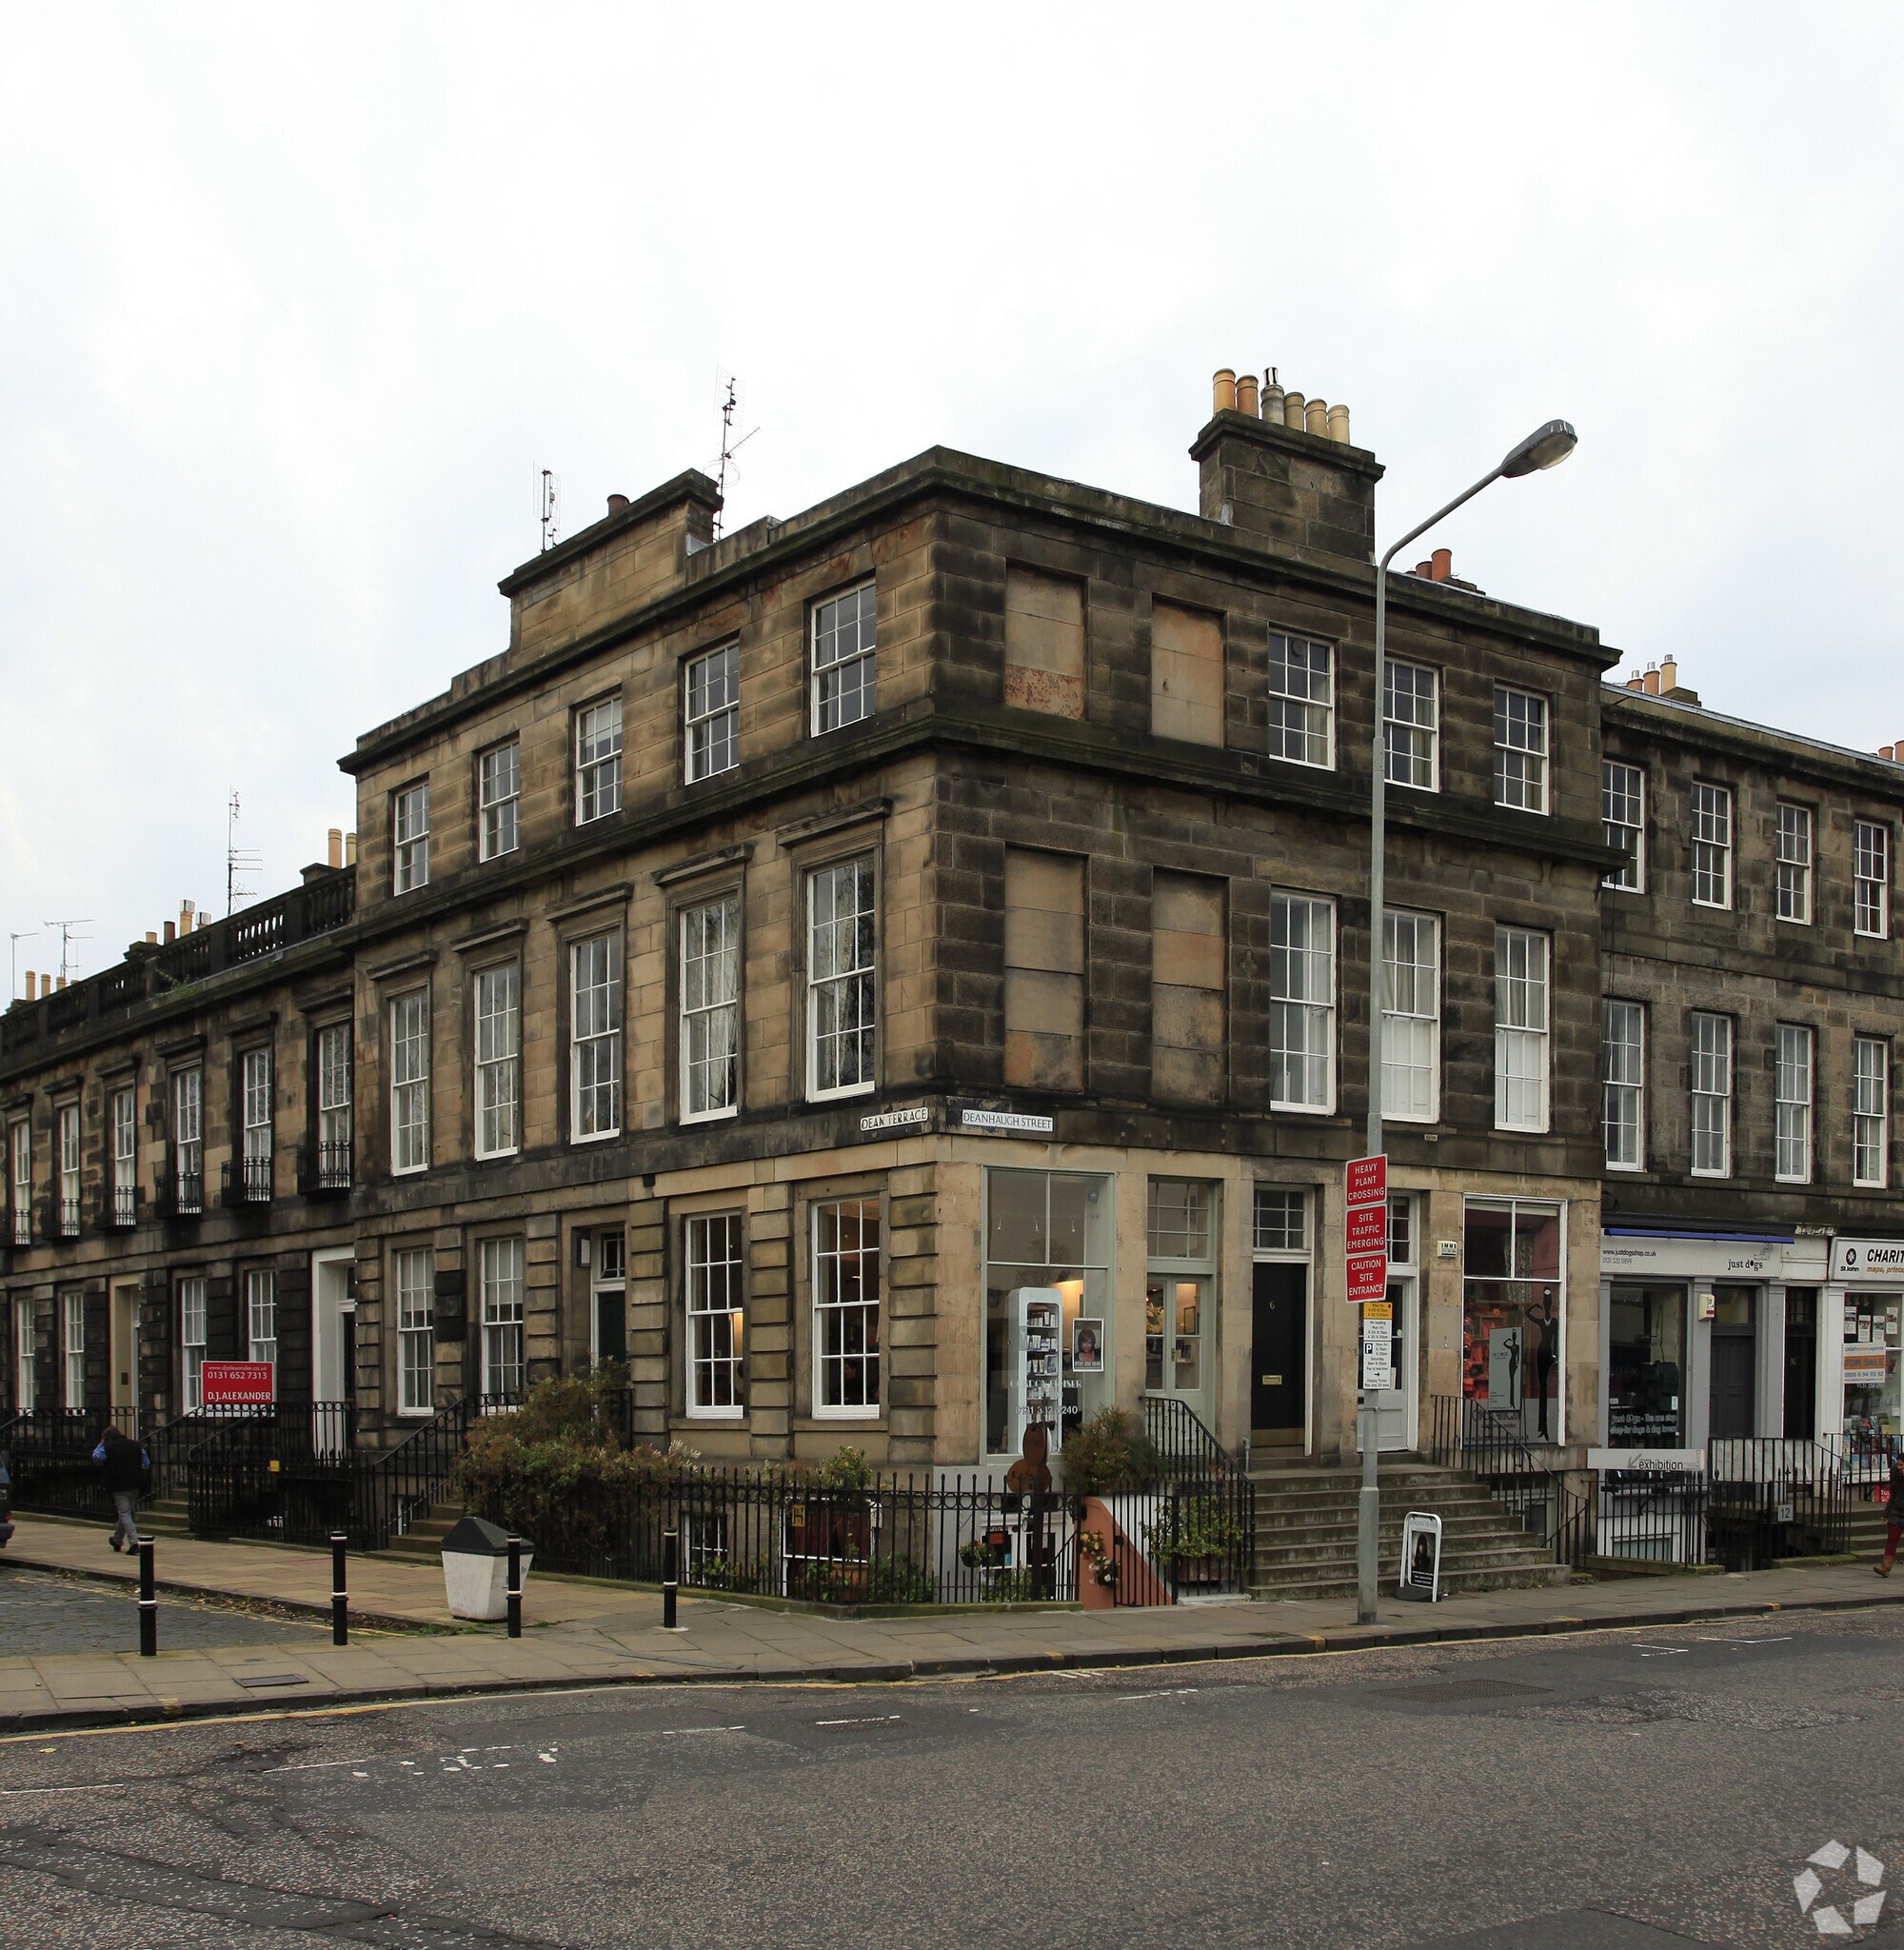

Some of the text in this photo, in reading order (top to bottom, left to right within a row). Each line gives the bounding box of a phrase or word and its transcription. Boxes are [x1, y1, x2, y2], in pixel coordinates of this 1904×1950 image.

[861, 1109, 927, 1130] DEAN TERRACE
[963, 1112, 1052, 1129] DEANHAUGH STREET
[1355, 1163, 1378, 1174] HEAVY
[1355, 1175, 1377, 1187] PLANT
[1348, 1187, 1384, 1200] CROSSING
[1359, 1213, 1373, 1222] SITE
[1352, 1224, 1380, 1236] TRAFFIC
[1347, 1237, 1384, 1250] EMERGING
[1603, 1249, 1656, 1257] www.justdogsshop.co.uk
[1351, 1259, 1381, 1271] CAUTION
[1728, 1259, 1743, 1270] just
[1359, 1273, 1373, 1282] SITE
[1349, 1284, 1383, 1296] ENTRANCE
[1269, 1301, 1275, 1310] 6
[1367, 1344, 1372, 1353] P
[208, 1392, 271, 1402] D.J.ALEXANDER
[1058, 1406, 1078, 1414] 240
[1639, 1459, 1684, 1470] exhibition
[1781, 1508, 1790, 1518] 12
